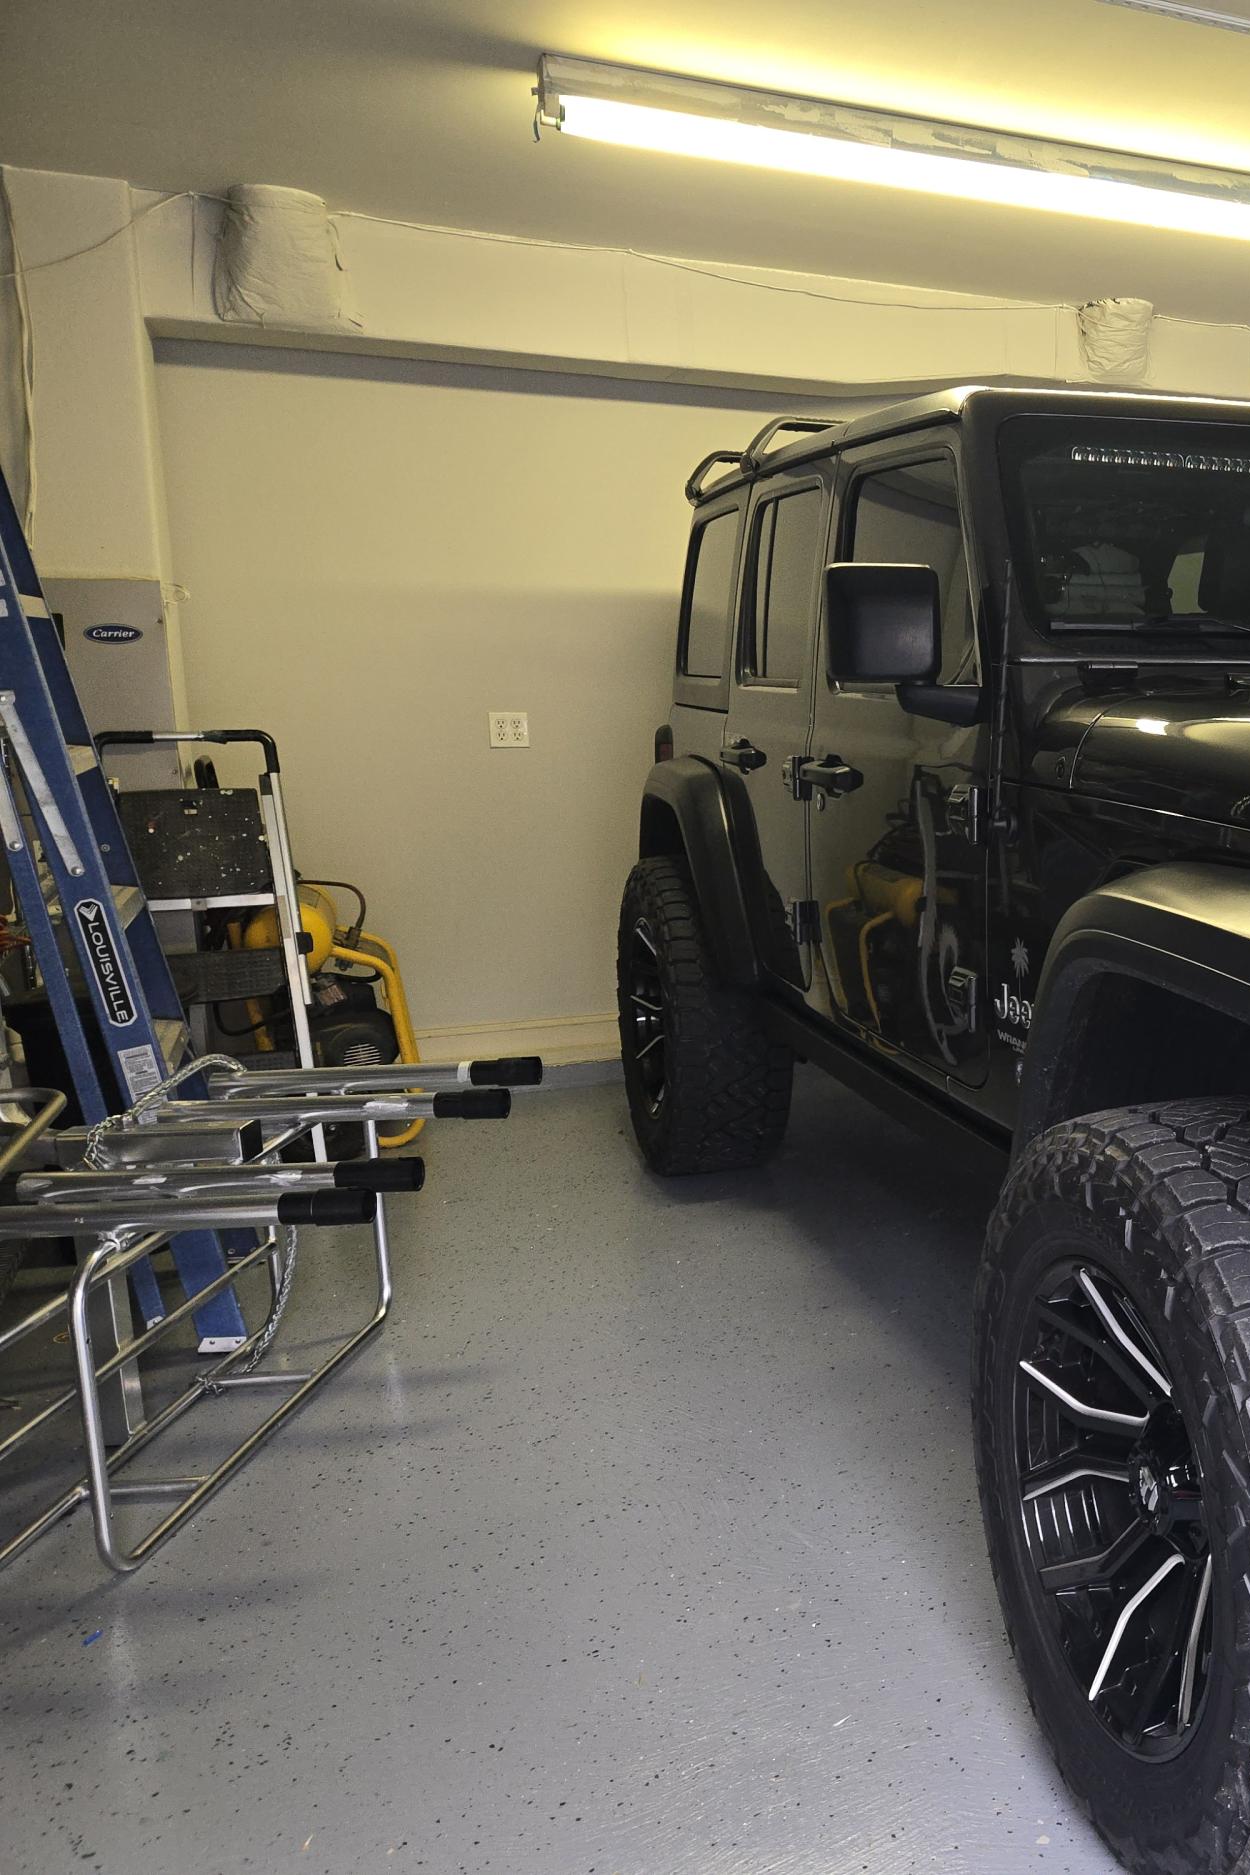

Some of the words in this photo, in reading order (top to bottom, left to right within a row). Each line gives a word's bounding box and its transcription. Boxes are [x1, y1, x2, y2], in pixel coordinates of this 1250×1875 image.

[92, 628, 135, 638] Carrier
[87, 921, 129, 1024] LOUISVILLE
[994, 983, 1034, 1029] Jee
[997, 1029, 1027, 1049] WRAN
